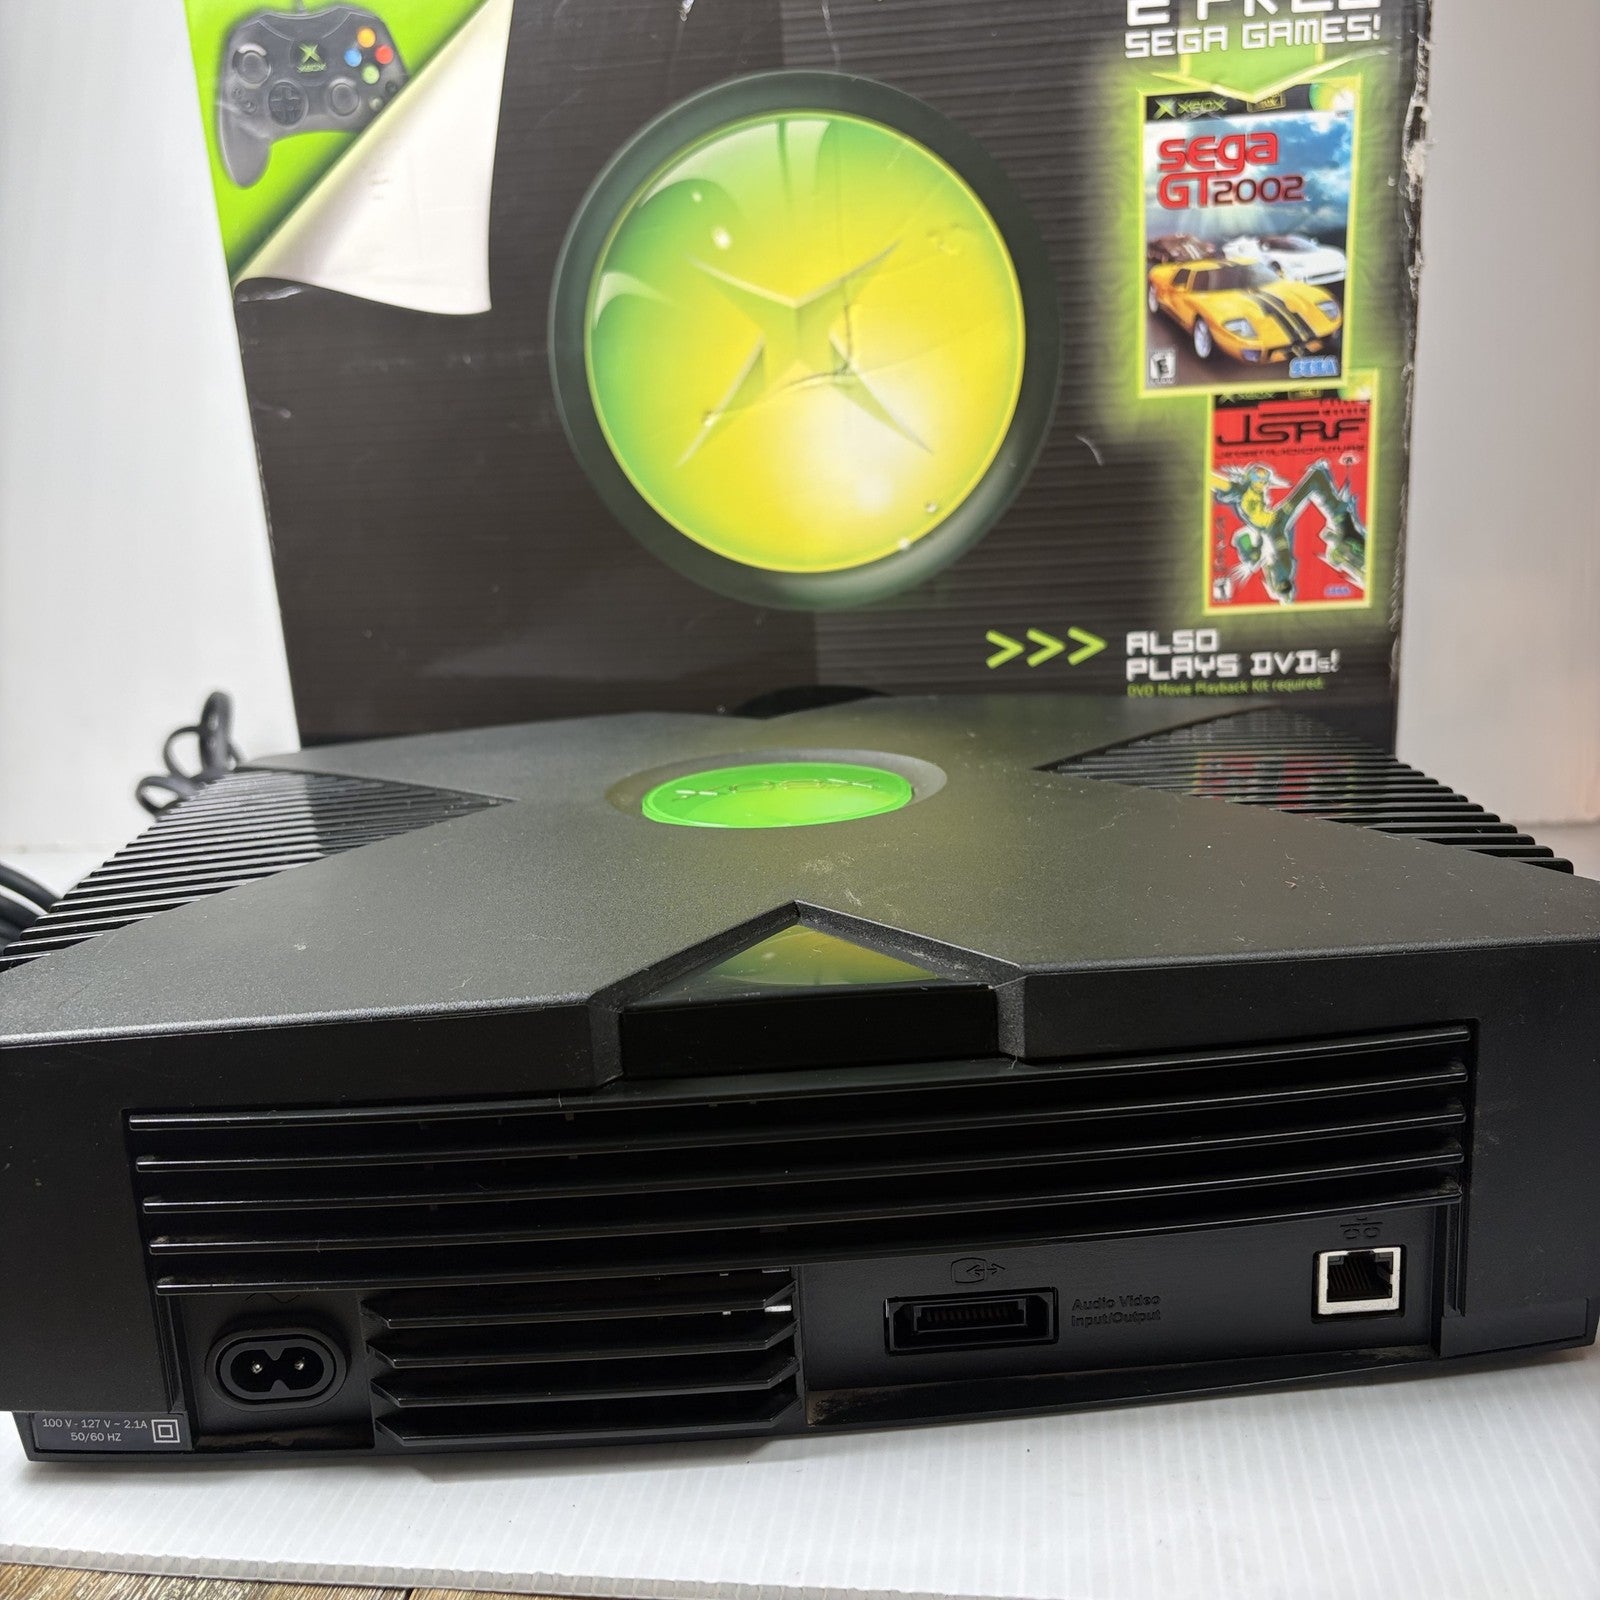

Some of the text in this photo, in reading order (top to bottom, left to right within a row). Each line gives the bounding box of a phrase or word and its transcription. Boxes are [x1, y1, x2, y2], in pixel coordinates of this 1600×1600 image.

[1124, 14, 1382, 58] SEGA GAMES!
[1126, 628, 1219, 656] ALSO
[1126, 653, 1241, 682] PLAYS
[1127, 683, 1154, 698] DVD
[1157, 683, 1192, 697] Movie
[1195, 680, 1248, 696] Playback
[1252, 678, 1270, 693] Kit
[1072, 1294, 1162, 1311] Audio Video
[1071, 1309, 1162, 1328] Input/Output
[42, 1418, 63, 1428] 100
[64, 1419, 72, 1428] V
[81, 1419, 100, 1428] 127
[103, 1419, 111, 1428] V
[123, 1419, 148, 1429] 2.1A
[70, 1432, 122, 1443] 50/60 HZ
